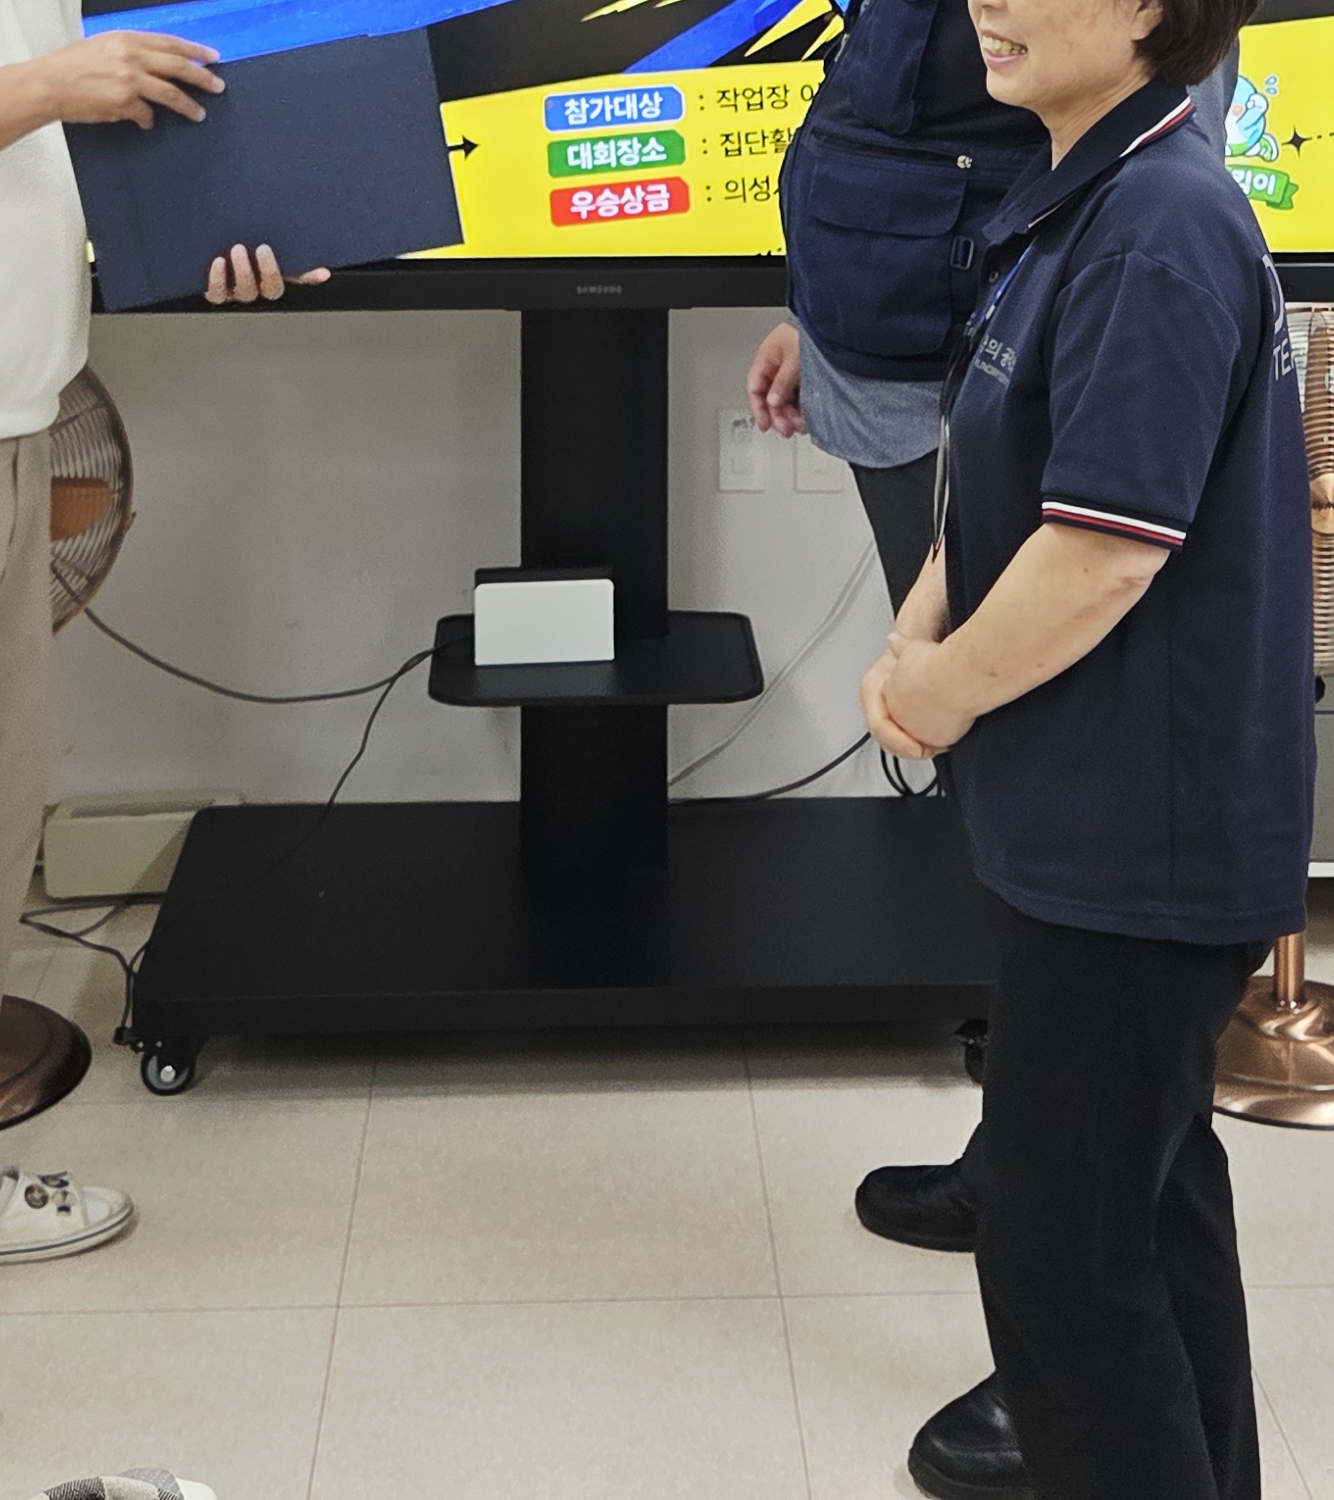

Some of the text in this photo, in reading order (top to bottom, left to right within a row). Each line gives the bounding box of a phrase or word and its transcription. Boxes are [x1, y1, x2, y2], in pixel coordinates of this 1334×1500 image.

[564, 91, 664, 125] 참가대상
[716, 83, 791, 113] 작업장
[566, 136, 667, 170] 대회장소
[570, 182, 670, 220] 우승상금
[724, 175, 780, 203] 의성
[981, 334, 1003, 361] 의
